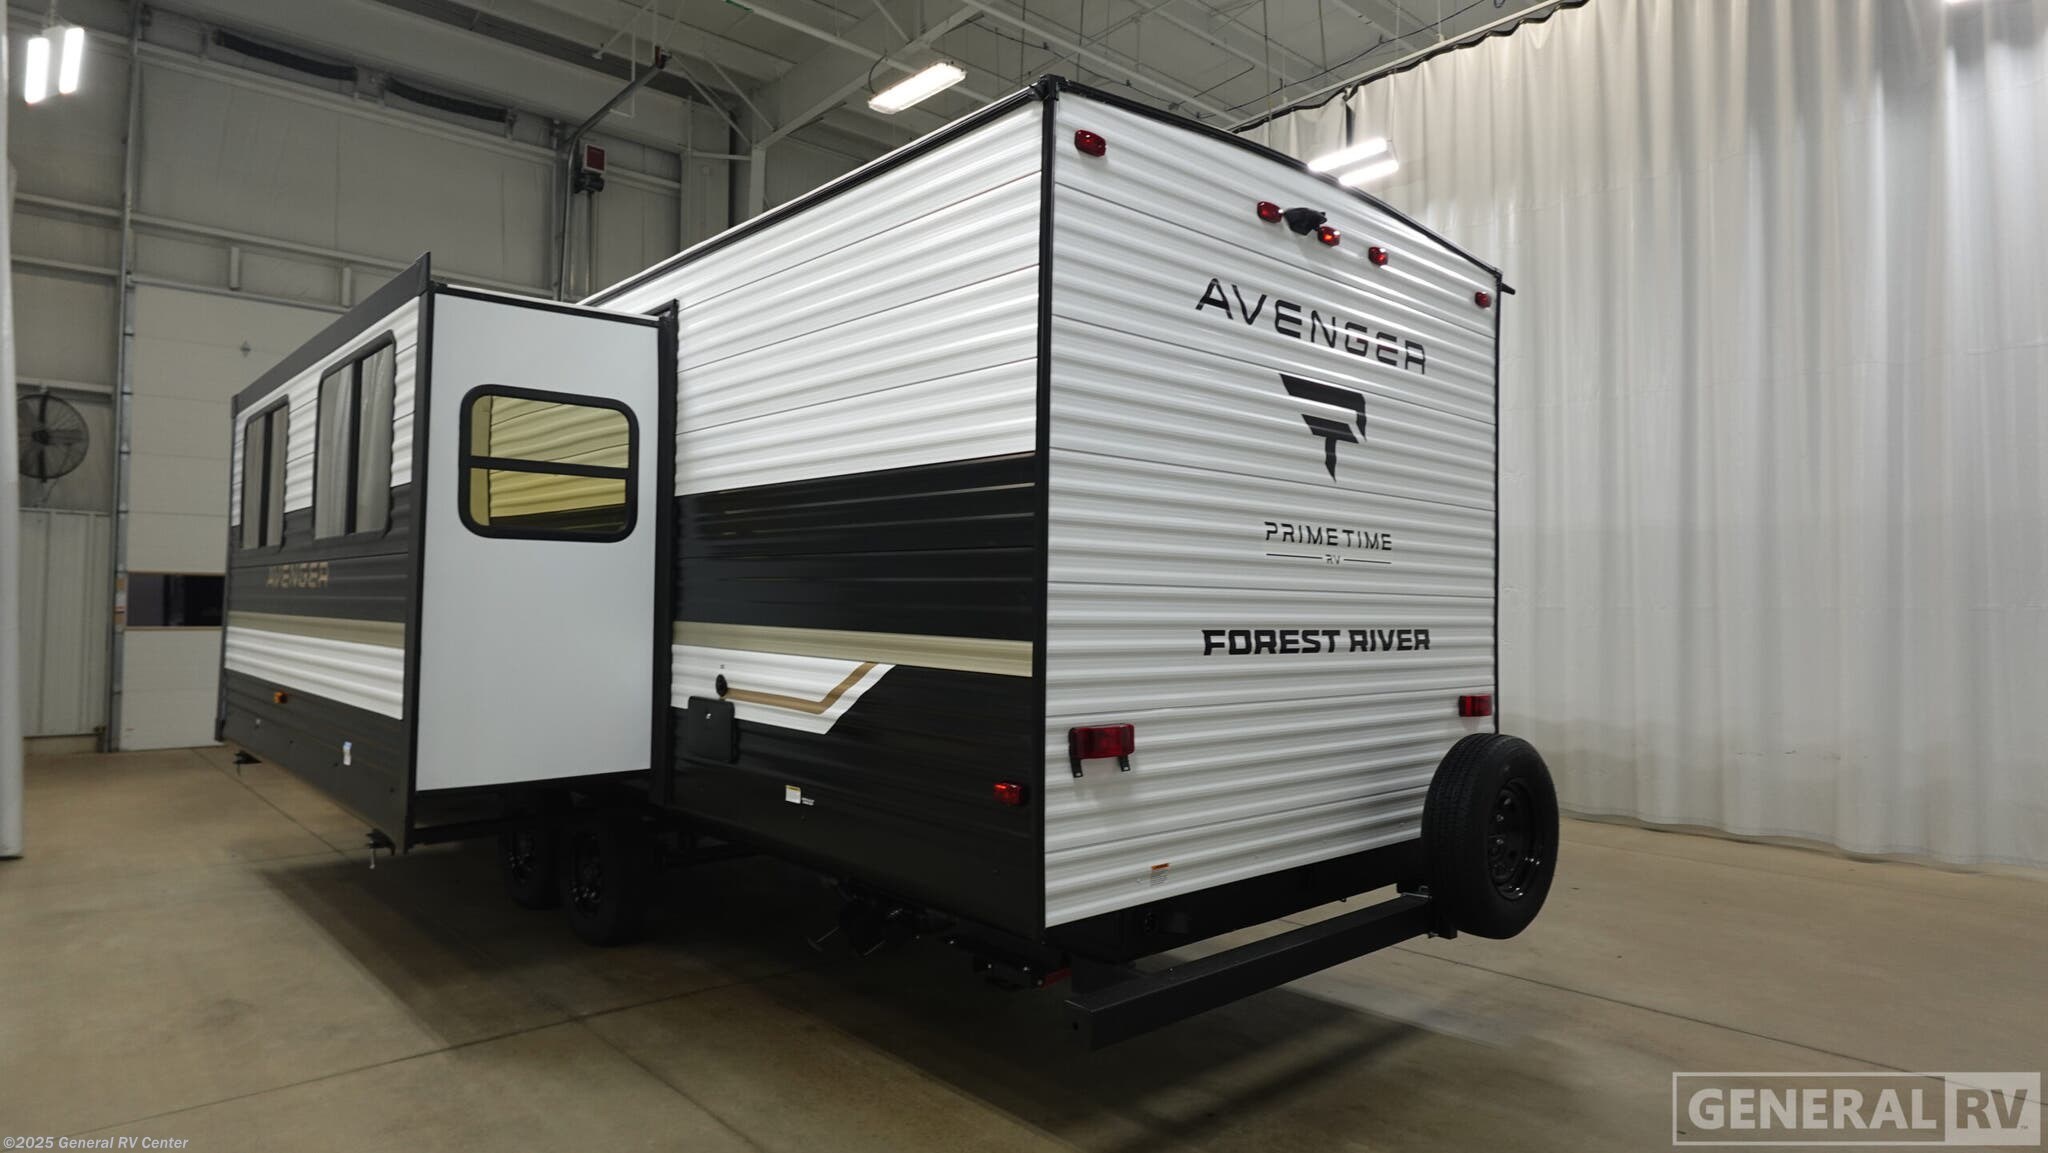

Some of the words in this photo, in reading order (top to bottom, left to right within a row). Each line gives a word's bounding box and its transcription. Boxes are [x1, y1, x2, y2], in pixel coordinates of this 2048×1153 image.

[1196, 278, 1426, 375] AVENGER
[1325, 554, 1341, 565] RV
[265, 561, 329, 589] AVENGER
[1201, 629, 1341, 656] FOREST
[1348, 629, 1431, 653] RIVER
